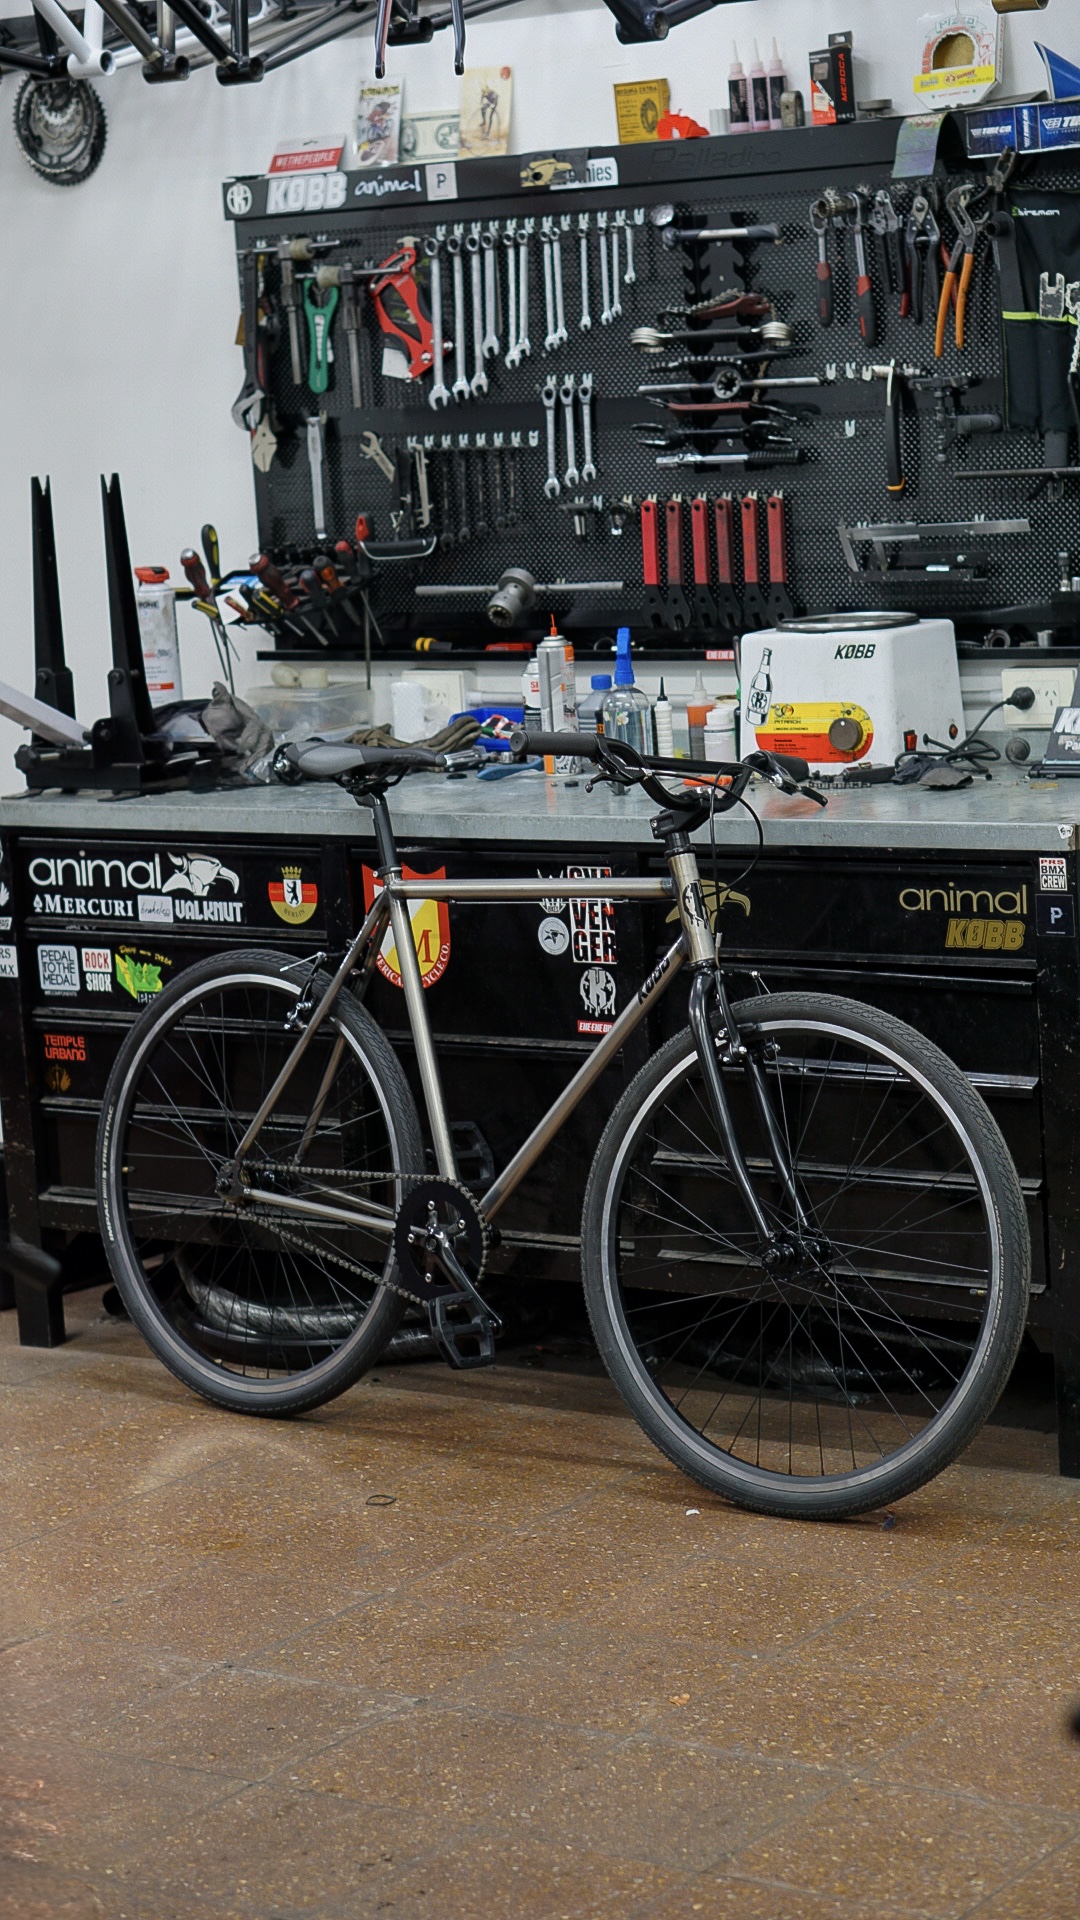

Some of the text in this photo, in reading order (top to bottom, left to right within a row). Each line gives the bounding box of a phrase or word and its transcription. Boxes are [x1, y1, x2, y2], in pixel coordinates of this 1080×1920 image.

[275, 151, 336, 167] WETHEPEOPLE
[355, 169, 422, 196] animal
[437, 173, 447, 189] P
[29, 850, 162, 889] animal
[1040, 866, 1065, 875] BMX
[1041, 875, 1066, 889] CREW
[44, 893, 134, 917] MERCURI
[899, 881, 1028, 915] animal
[175, 899, 243, 923] VALKNUT
[1050, 907, 1063, 924] P
[40, 949, 75, 962] PEDAL
[84, 951, 110, 969] ROCK
[42, 973, 77, 986] MEDAL
[376, 954, 404, 988] ERICA
[422, 961, 445, 988] YCLE
[85, 973, 113, 993] SHOX
[44, 1034, 86, 1048] TEMPLE
[45, 1047, 87, 1061] URBANO
[101, 1104, 115, 1242] IMPAC STREETPAC
